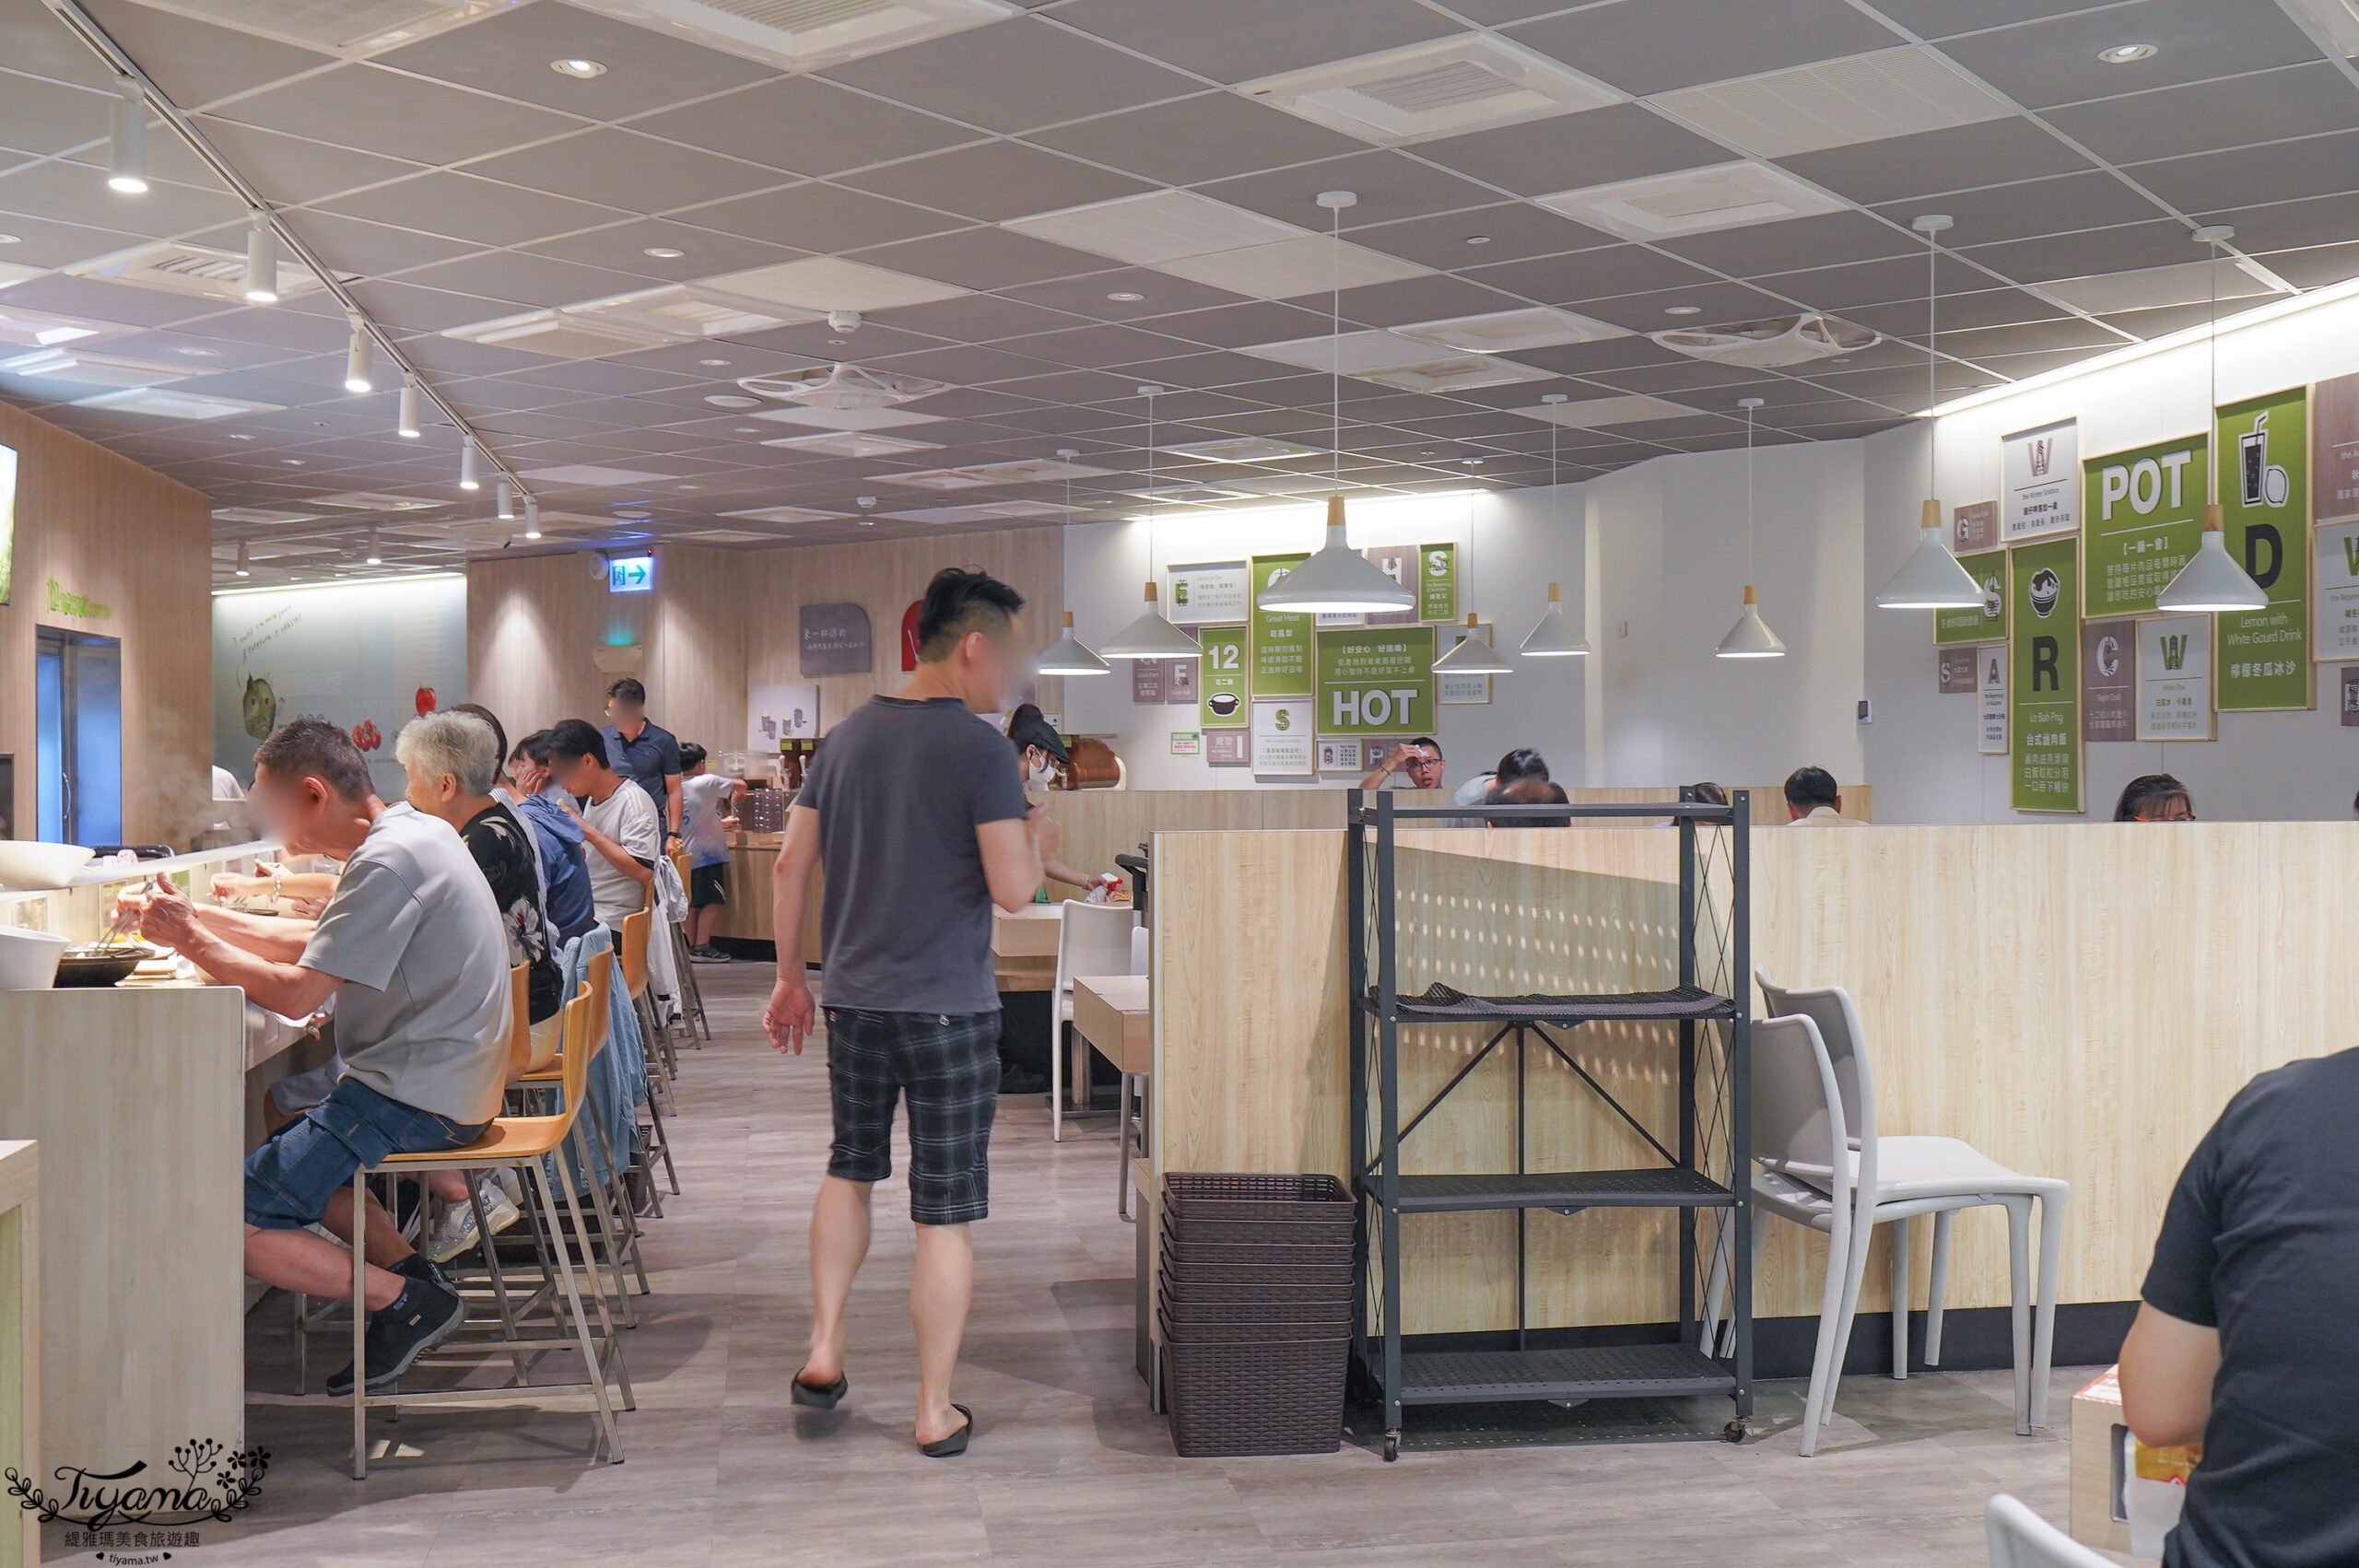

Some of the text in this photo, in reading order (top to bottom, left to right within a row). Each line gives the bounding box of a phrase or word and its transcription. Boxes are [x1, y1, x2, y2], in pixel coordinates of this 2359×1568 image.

[2027, 438, 2053, 477] W
[2102, 450, 2192, 521] POT
[1429, 550, 1448, 577] S
[2245, 523, 2283, 589] D
[2227, 627, 2302, 645] White Gourd Drink
[2241, 613, 2287, 628] Lemon with
[1209, 644, 1239, 670] 12
[2033, 636, 2060, 692] R
[2096, 636, 2118, 677] C
[2160, 635, 2188, 671] W
[2230, 660, 2296, 679] 檸檬冬瓜冰沙
[1275, 708, 1290, 731] S
[1333, 689, 1418, 726] HOT
